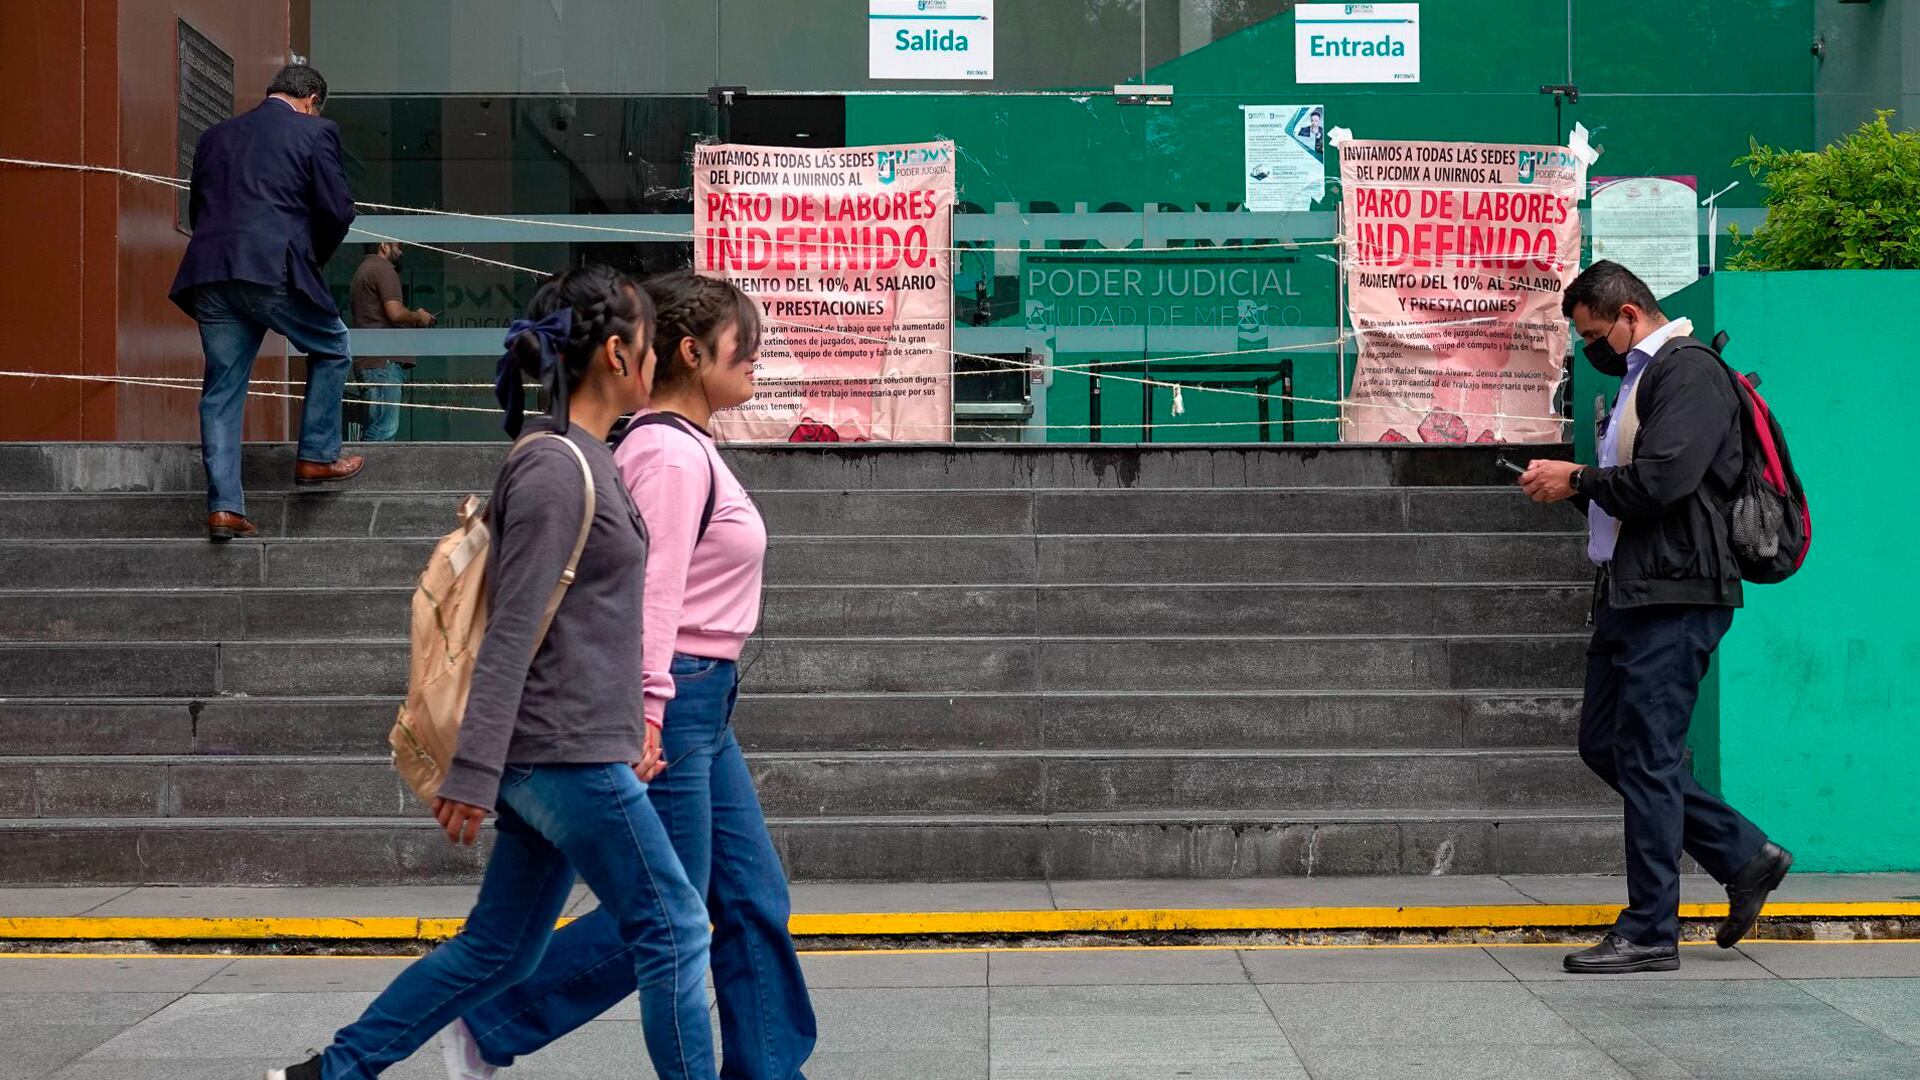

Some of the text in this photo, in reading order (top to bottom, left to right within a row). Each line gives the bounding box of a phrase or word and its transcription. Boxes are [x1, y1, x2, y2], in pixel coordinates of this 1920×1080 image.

[895, 29, 969, 52] Salida
[1310, 34, 1405, 57] Entrada
[698, 151, 759, 167] INVITAMOS
[762, 152, 771, 167] A
[774, 153, 812, 168] TODAS
[839, 151, 875, 168] SEDES
[1344, 146, 1516, 166] INVITAMOS A TODAS LAS SEDES
[710, 170, 864, 187] DEL PJCDMX A UNIRNOS AL
[896, 167, 920, 177] PODER
[1357, 166, 1503, 184] DEL PJCDMX A UNIRNOS AL
[707, 190, 937, 222] PARO DE LABORES
[1356, 187, 1570, 224] PARO DE LABORES
[705, 224, 937, 271] INDEFINIDO.
[1356, 223, 1565, 273] INDEFINIDO.
[719, 275, 936, 293] MENTO DEL 10% AL SALARIO
[1028, 269, 1301, 297] PODER JUDICIAL
[1359, 273, 1562, 294] AUMENTO DEL 10% AL SALARIO
[762, 300, 885, 316] Y PRESTACIONES
[1398, 296, 1517, 313] Y PRESTACIONES
[770, 325, 788, 336] gran
[836, 324, 865, 334] trabajo
[867, 325, 880, 334] que
[902, 321, 946, 332] aumentado
[1360, 318, 1369, 326] No
[764, 335, 808, 346] extinciones
[809, 336, 819, 346] de
[819, 336, 857, 348] juzgados,
[899, 334, 907, 344] la
[908, 335, 926, 346] gran
[1442, 329, 1452, 338] de
[760, 348, 792, 359] sistema,
[794, 348, 821, 360] equipo
[822, 348, 832, 358] de
[893, 347, 903, 357] de
[1432, 342, 1455, 352] equipo
[1395, 366, 1417, 376] Rafael
[1418, 367, 1443, 376] Guerra
[915, 376, 937, 387] digna
[1408, 378, 1440, 388] cantidad
[1442, 380, 1451, 388] de
[1452, 381, 1480, 391] trabajo
[1481, 381, 1522, 391] innecesaria
[1522, 384, 1536, 392] que
[755, 388, 936, 400] gran cantidad de trabajo innecesaria que por sus
